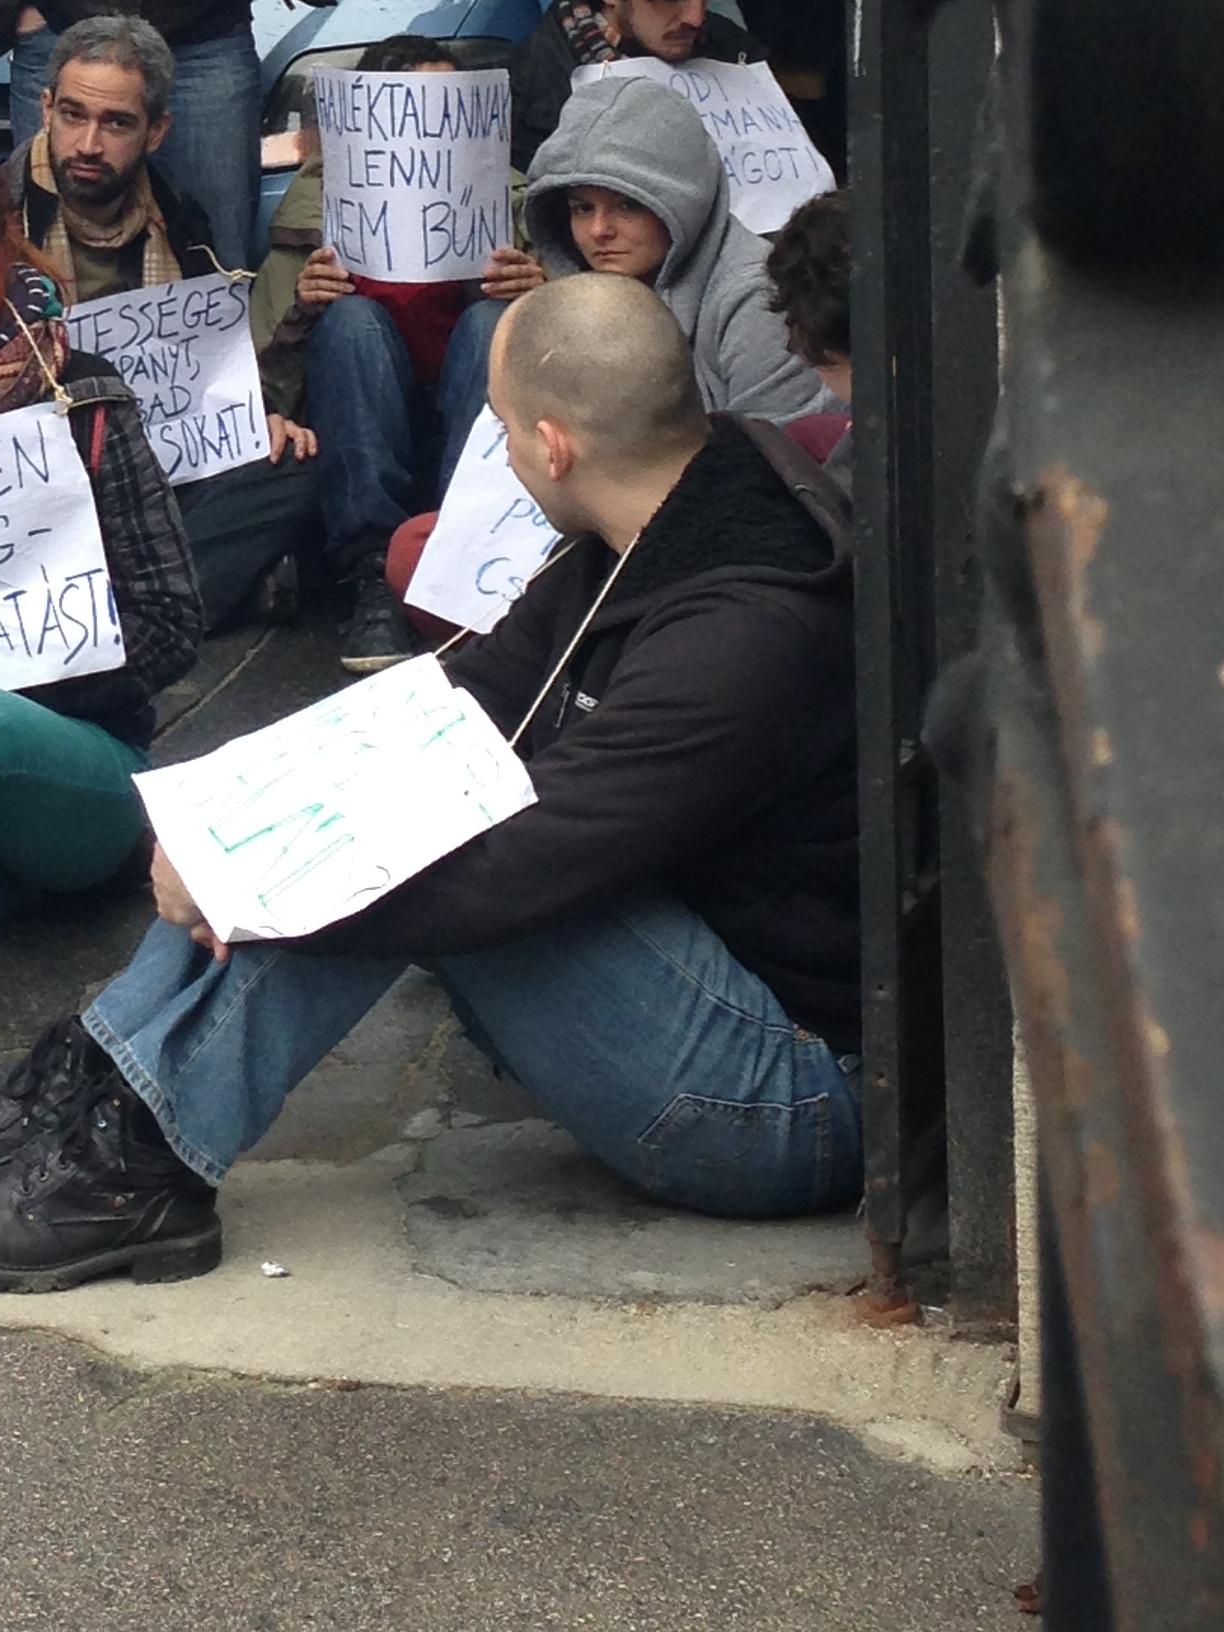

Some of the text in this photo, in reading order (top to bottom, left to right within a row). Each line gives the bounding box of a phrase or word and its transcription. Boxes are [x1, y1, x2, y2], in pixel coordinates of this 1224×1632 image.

[347, 144, 452, 194] LENNI
[325, 193, 393, 272] NEM
[67, 284, 246, 356] TESSÉGES
[160, 390, 261, 476] SOKAT!
